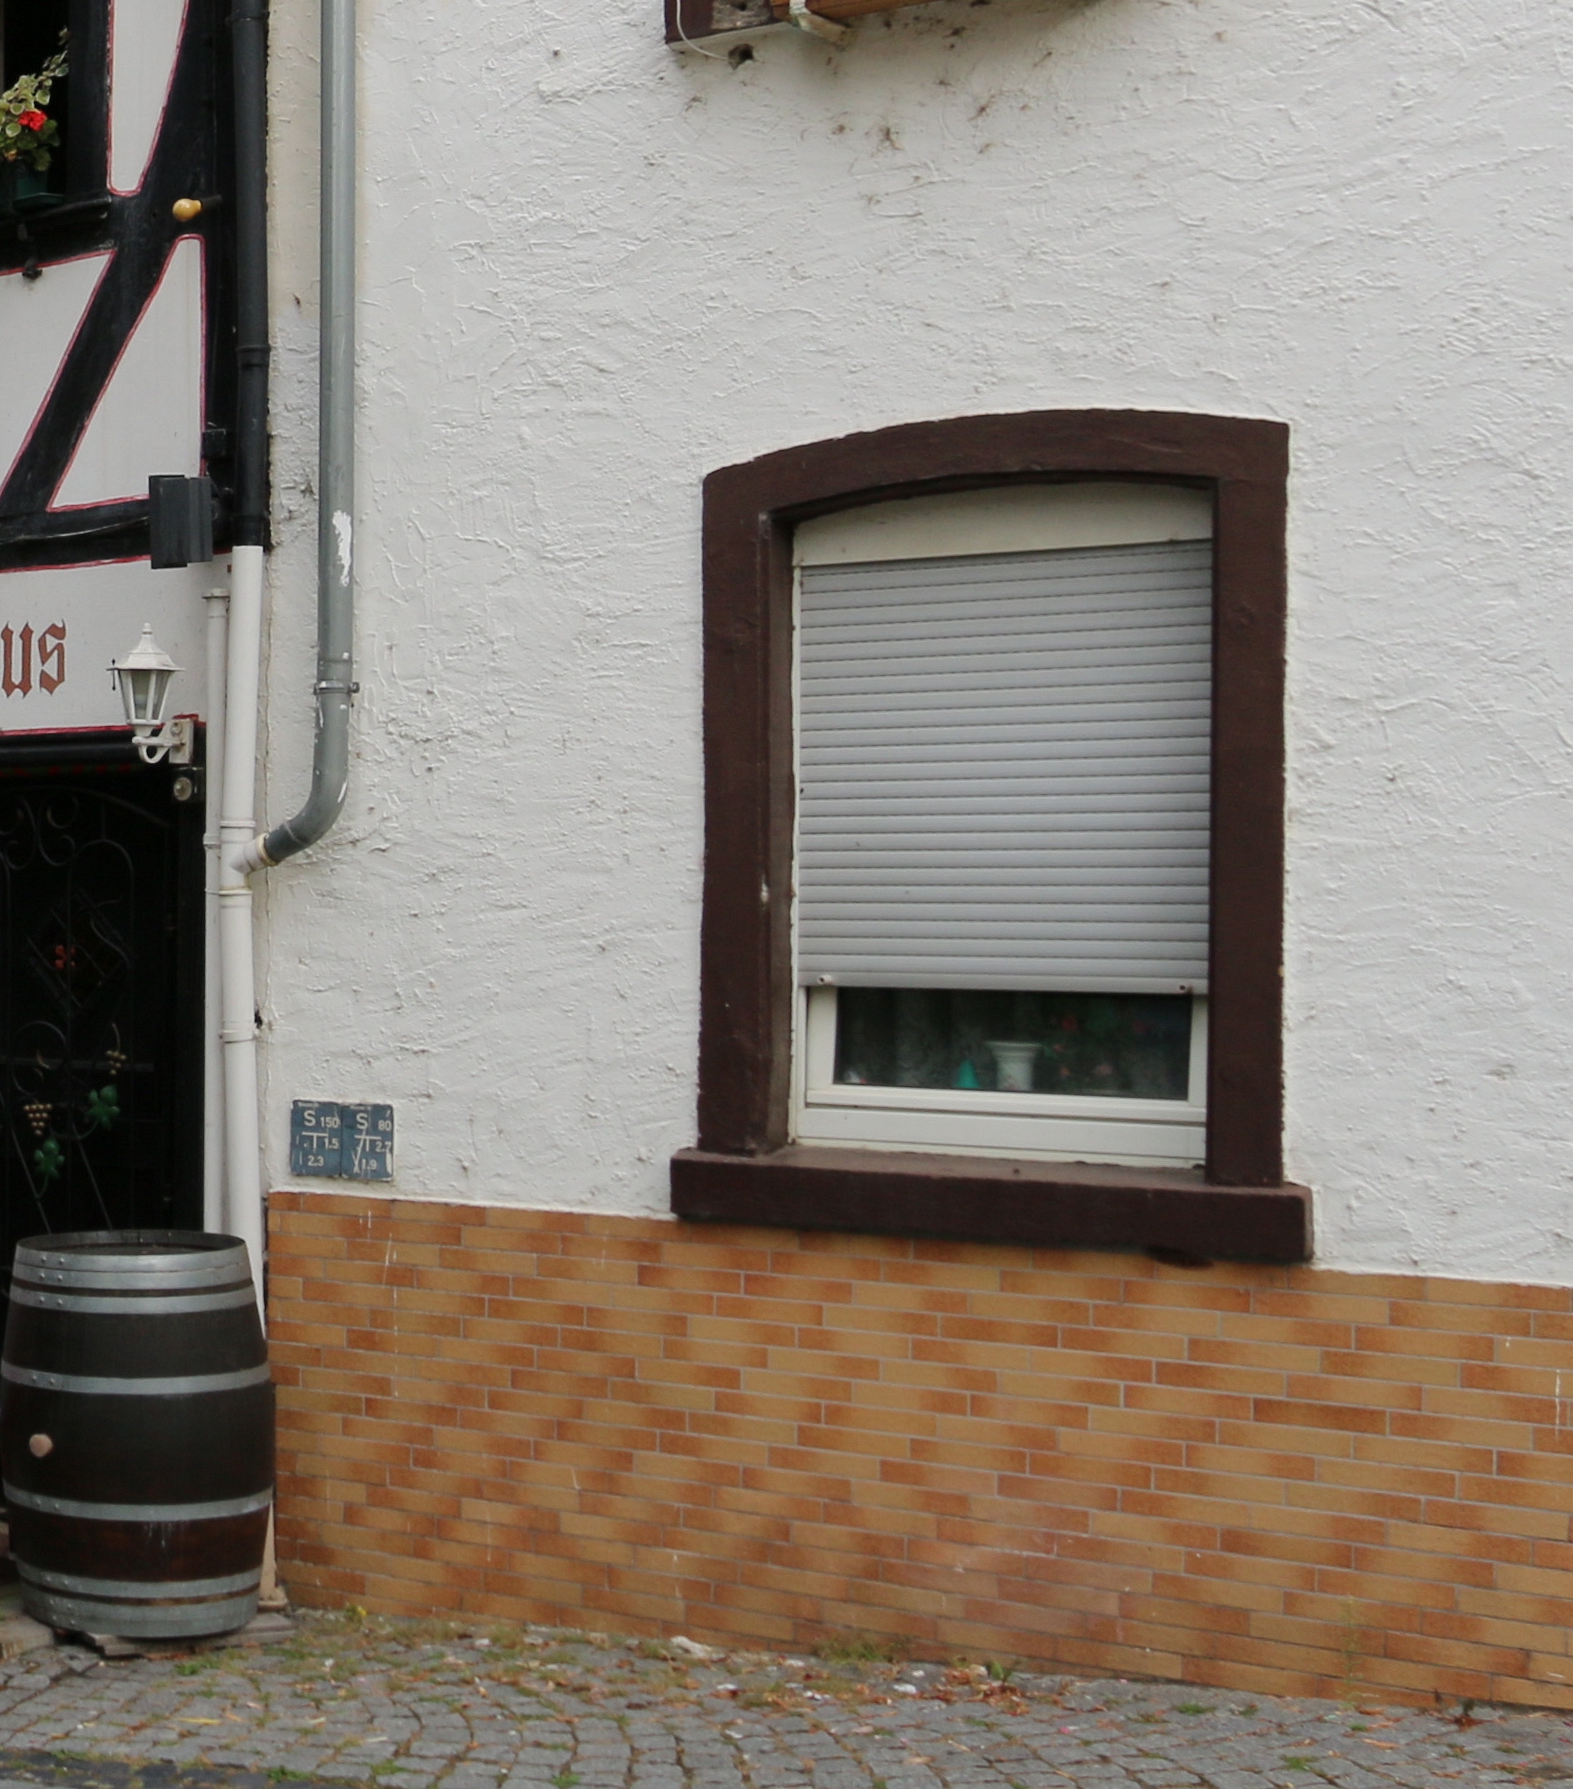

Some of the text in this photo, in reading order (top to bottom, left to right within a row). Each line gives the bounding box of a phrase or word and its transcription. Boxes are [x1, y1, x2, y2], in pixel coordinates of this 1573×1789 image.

[304, 1110, 339, 1128] S 150
[356, 1113, 392, 1131] S 80
[307, 1155, 324, 1167] 2.3
